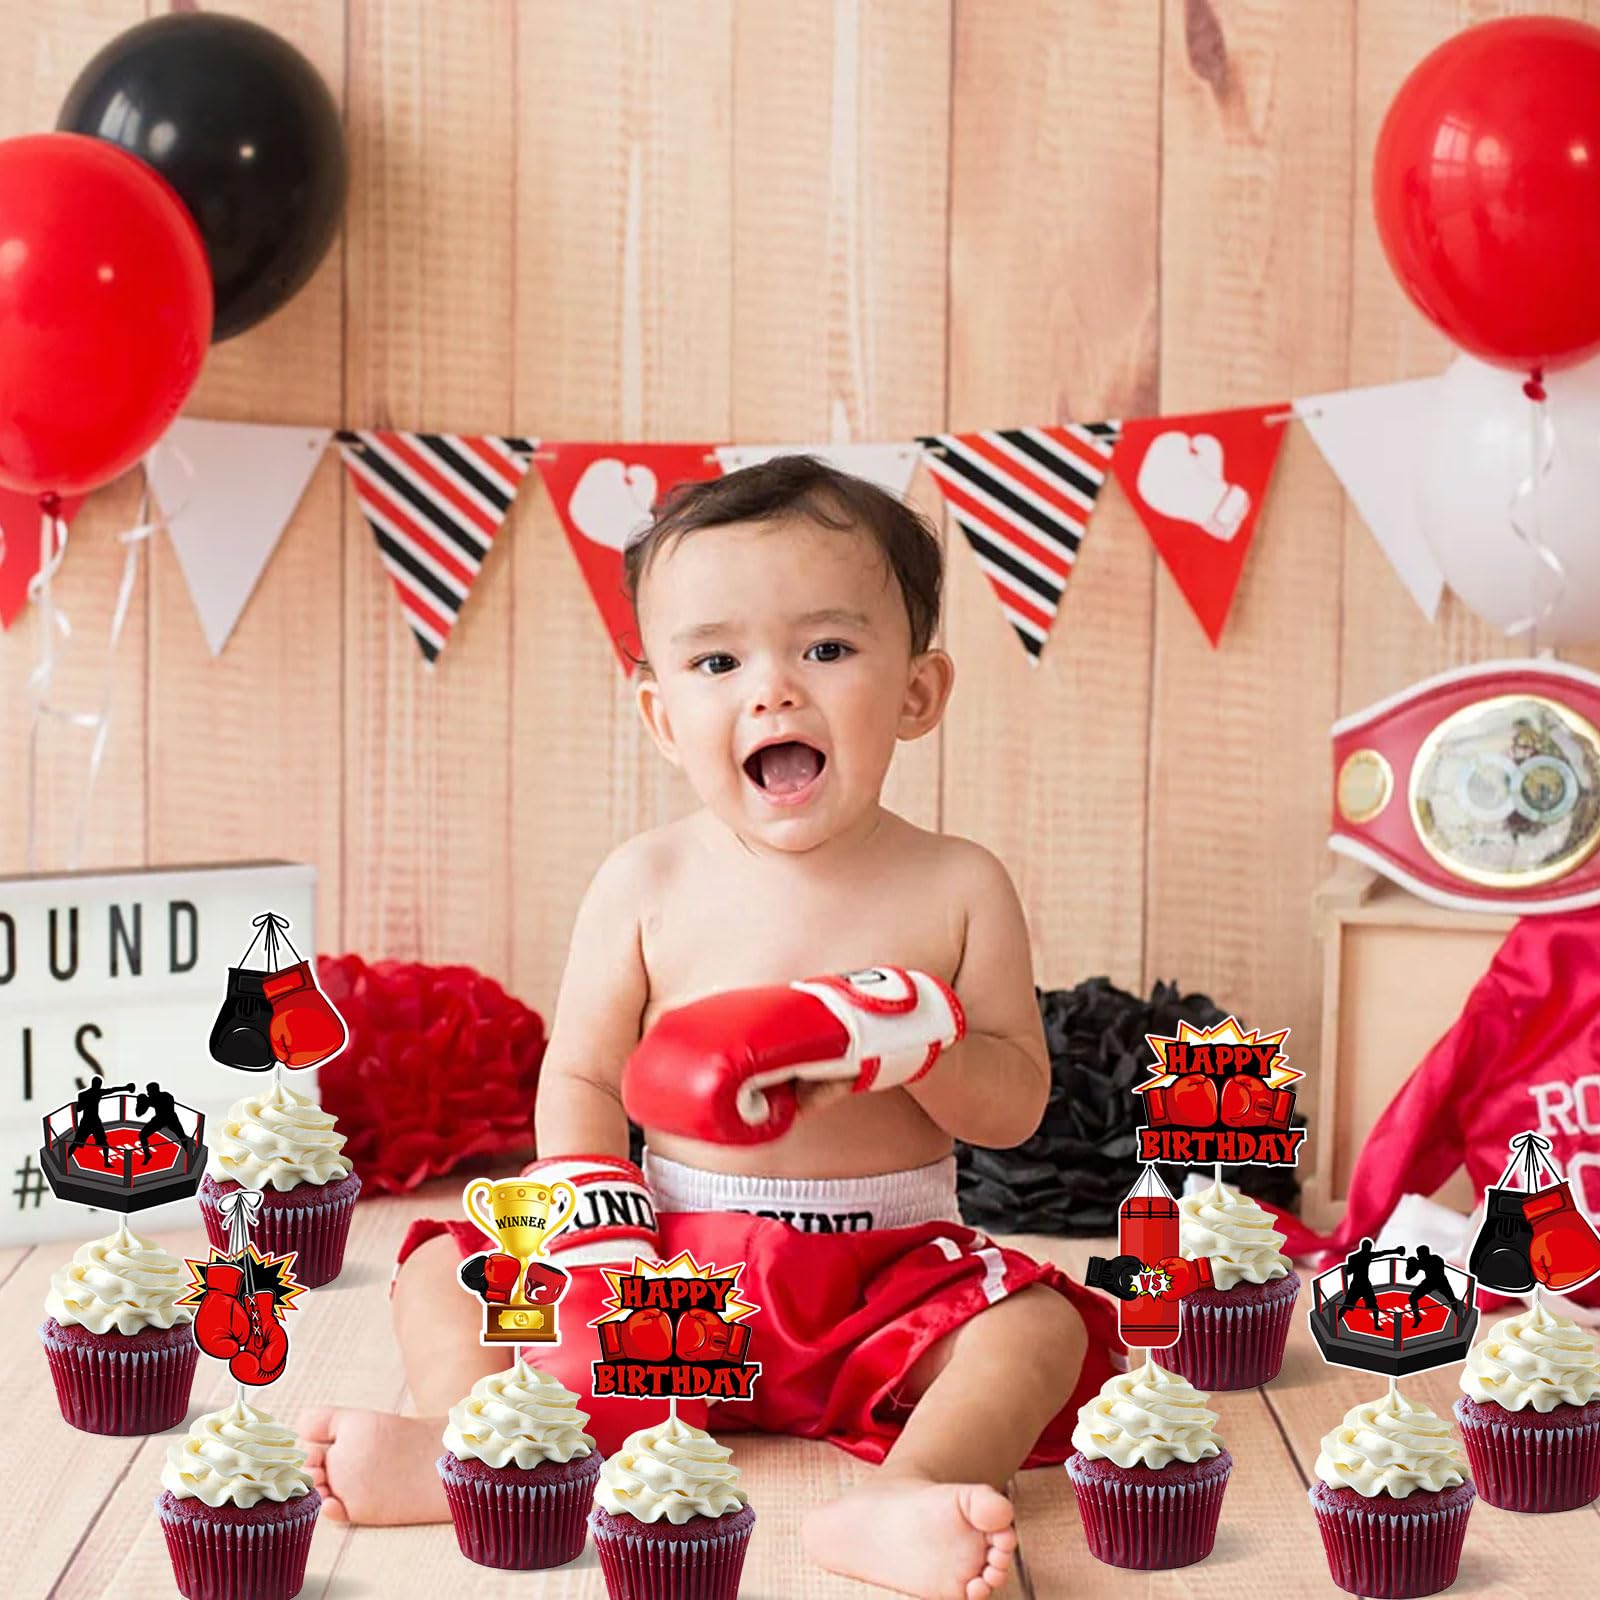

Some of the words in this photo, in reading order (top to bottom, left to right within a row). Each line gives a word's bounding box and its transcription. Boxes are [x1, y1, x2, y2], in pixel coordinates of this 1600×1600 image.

[1167, 1044, 1277, 1076] HAPPY
[1141, 1131, 1303, 1162] BIRTHDAY
[495, 1215, 546, 1230] WINNER
[622, 1278, 733, 1310] HAPPY
[1139, 1274, 1162, 1292] VS
[596, 1365, 757, 1396] BIRTHDAY
